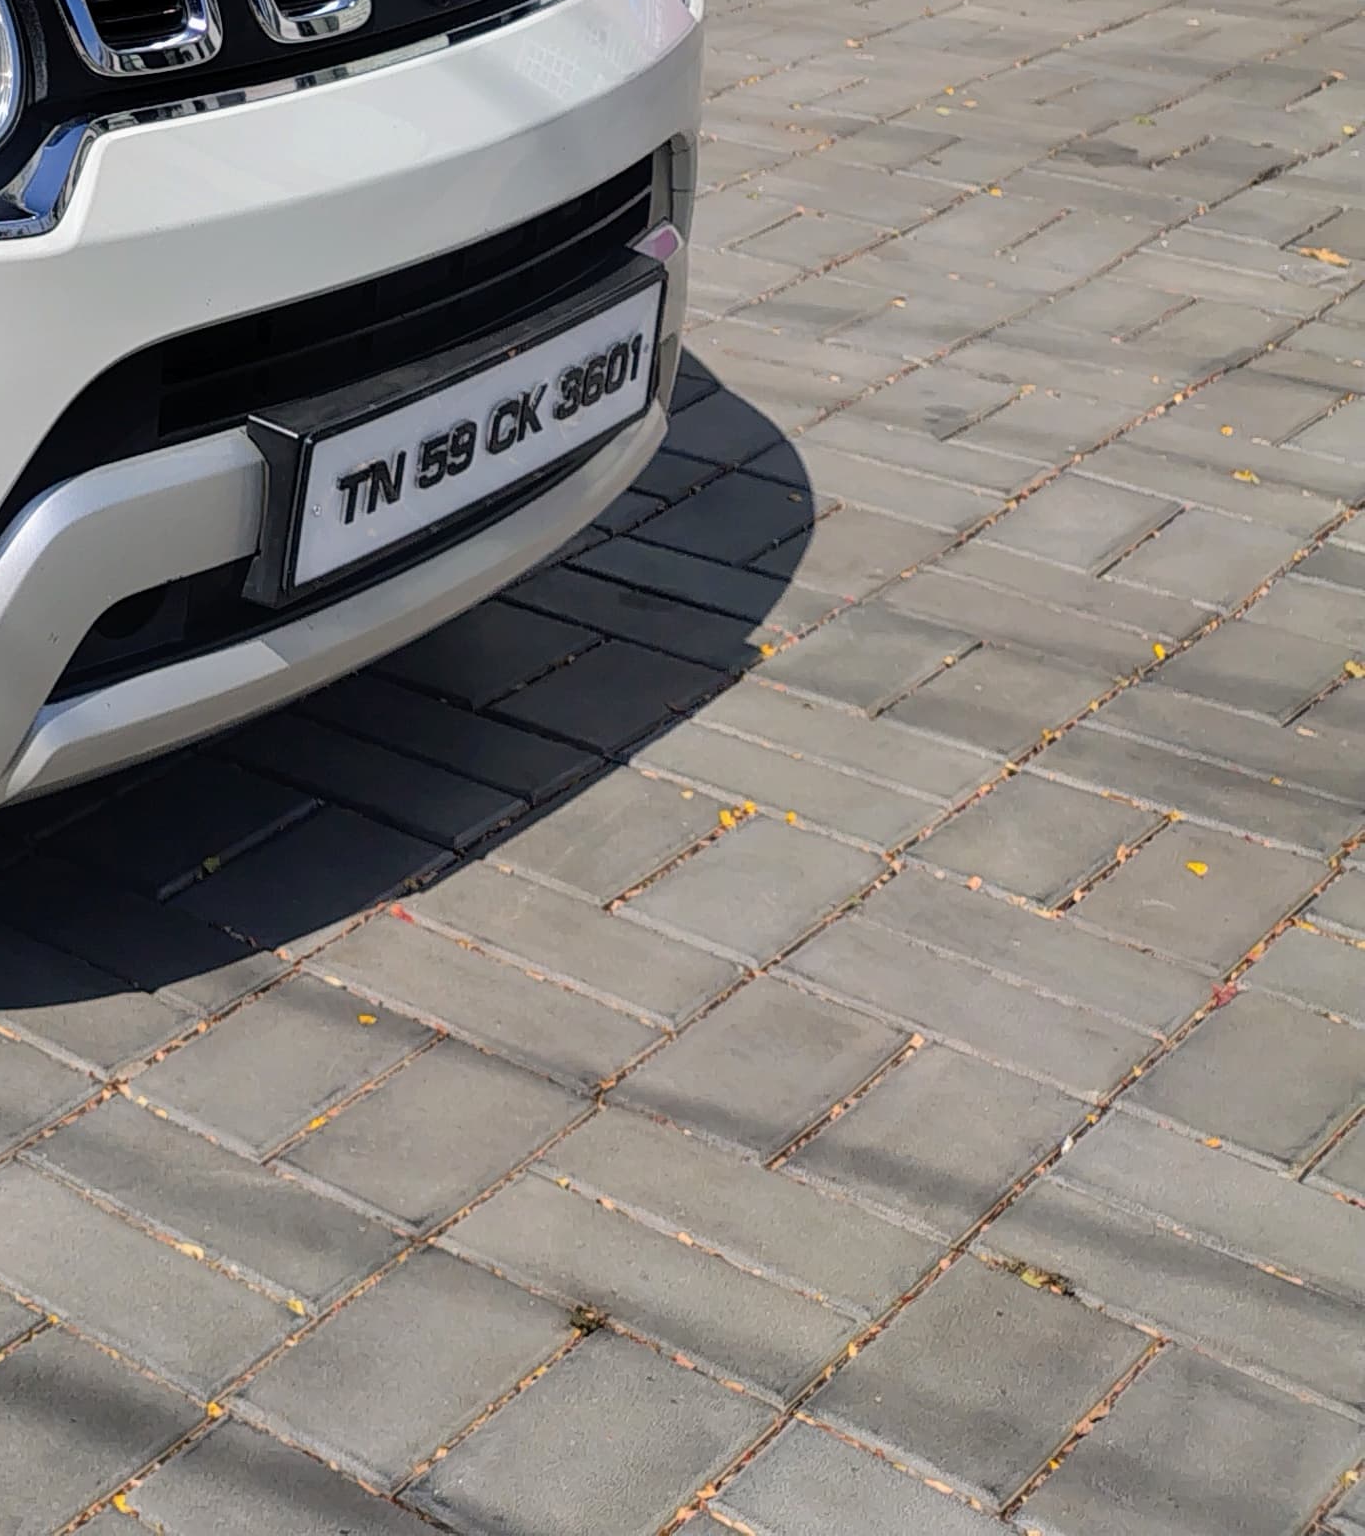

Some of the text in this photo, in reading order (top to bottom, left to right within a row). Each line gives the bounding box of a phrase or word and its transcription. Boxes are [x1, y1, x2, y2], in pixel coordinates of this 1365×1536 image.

[336, 333, 642, 524] TN 59 CK 3601
